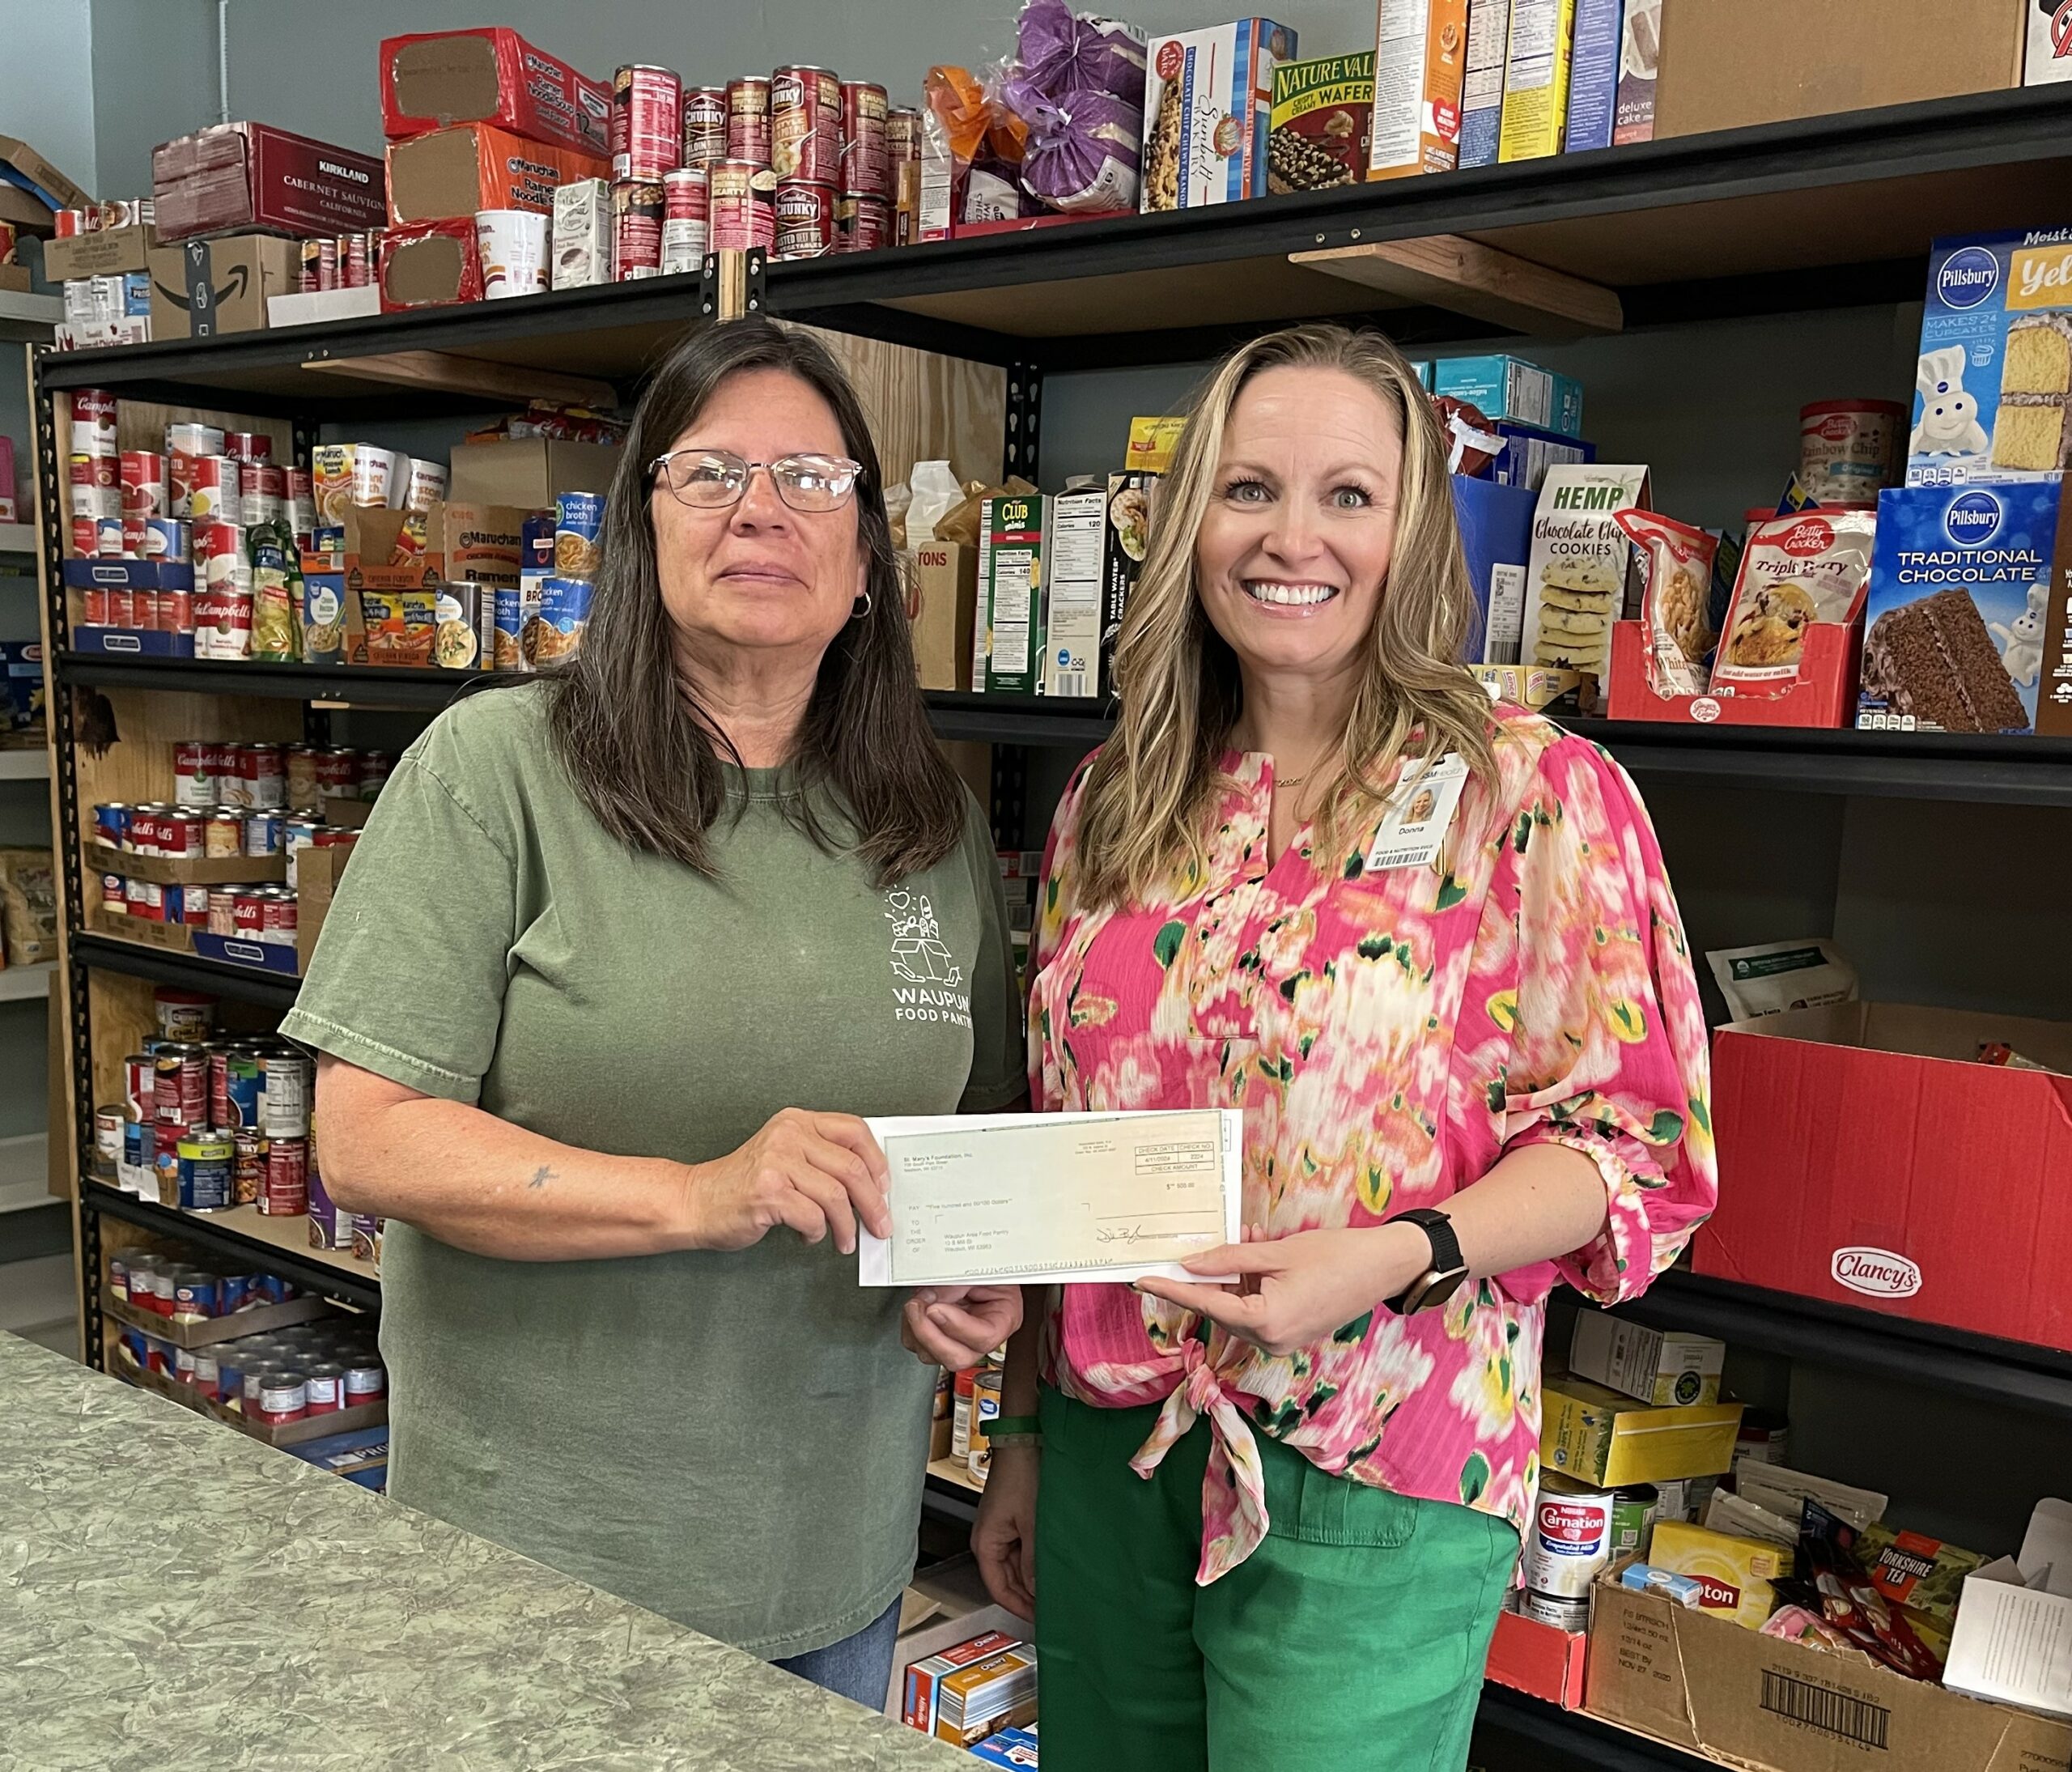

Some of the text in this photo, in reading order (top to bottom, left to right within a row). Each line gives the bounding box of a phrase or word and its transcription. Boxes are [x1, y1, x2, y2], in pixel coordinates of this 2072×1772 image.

[1276, 58, 1341, 103] NATURE
[1318, 84, 1374, 104] WAFER
[1619, 100, 1653, 116] deluxe
[575, 112, 591, 135] 12
[686, 111, 726, 125] CHUNKY
[1618, 113, 1641, 126] cake
[1191, 106, 1201, 179] BAKERY
[319, 161, 370, 185] KIRKLAND
[517, 158, 560, 179] Maruchan
[283, 174, 386, 212] CABERNET SAUVIGN
[524, 177, 554, 194] Rame
[319, 199, 367, 219] CALIFORNIA
[2024, 229, 2067, 246] Moist
[1942, 269, 1996, 288] Pillsbury
[2019, 254, 2072, 297] Yel
[1926, 313, 1998, 330] MAKES 24
[1925, 324, 1997, 340] CUPCAKES
[78, 397, 117, 414] Campb
[1851, 441, 1880, 459] Chip
[566, 500, 597, 512] chicken
[1553, 487, 1625, 511] HEMP
[565, 511, 588, 520] broth
[1002, 503, 1028, 521] CLUB
[1949, 509, 1999, 529] Pillsbury
[1004, 520, 1025, 532] minis
[1535, 517, 1594, 542] Chocolate
[1794, 524, 1824, 540] Betty
[469, 531, 521, 546] Maruchan
[1785, 535, 1829, 550] Crocker
[1549, 543, 1611, 556] COOKIES
[1897, 549, 2044, 567] TRADITIONAL
[465, 568, 520, 584] Ramen
[1111, 559, 1119, 593] WATER
[1802, 559, 1849, 576] Brry
[1898, 566, 2036, 584] CHOCOLATE
[1117, 573, 1127, 620] CRACKERS
[1506, 672, 1516, 697] Lance
[177, 753, 217, 768] Campbell
[1398, 826, 1424, 835] Donna
[892, 988, 970, 1013] WAUPUN
[894, 1007, 938, 1022] FOOD
[1836, 1254, 1918, 1290] Clancy's
[1540, 1506, 1603, 1529] Carnation
[1879, 1546, 1935, 1579] YORKSHIRE
[1885, 1566, 1907, 1587] TEA
[1620, 1647, 1640, 1660] BEST
[1618, 1657, 1636, 1670] NOV
